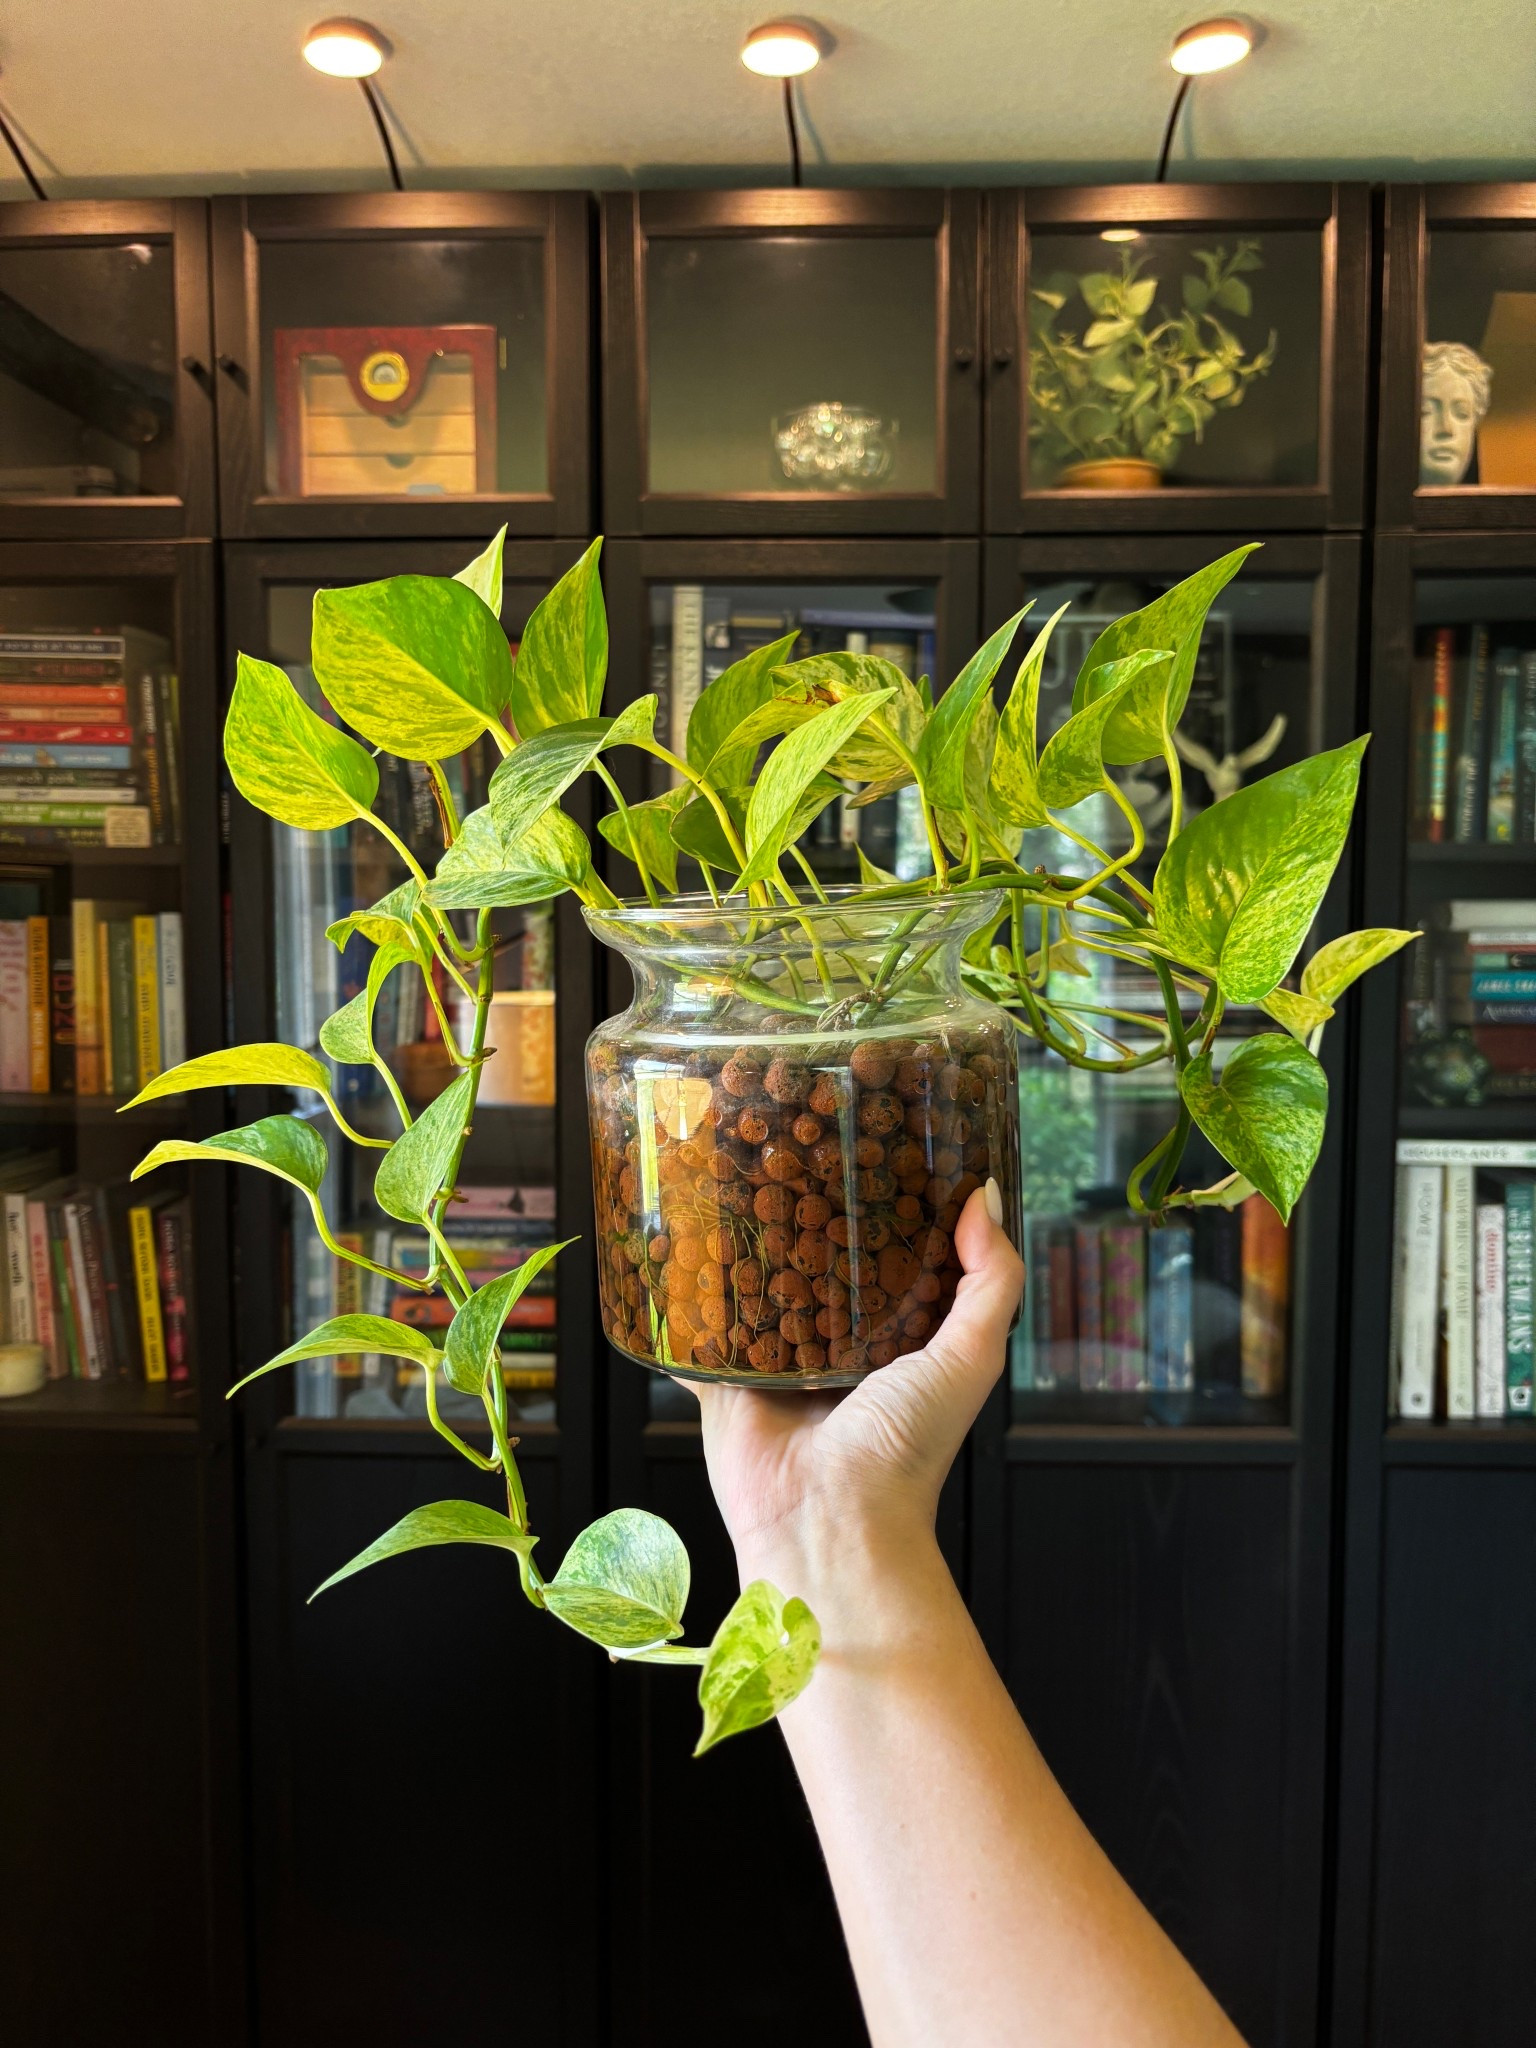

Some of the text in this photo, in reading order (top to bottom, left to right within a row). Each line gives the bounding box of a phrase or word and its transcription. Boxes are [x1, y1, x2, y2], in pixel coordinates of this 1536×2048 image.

[1402, 1145, 1509, 1159] HOUSEPLANTS
[1485, 1227, 1499, 1292] domino
[1507, 1230, 1532, 1354] BOHEMIANS
